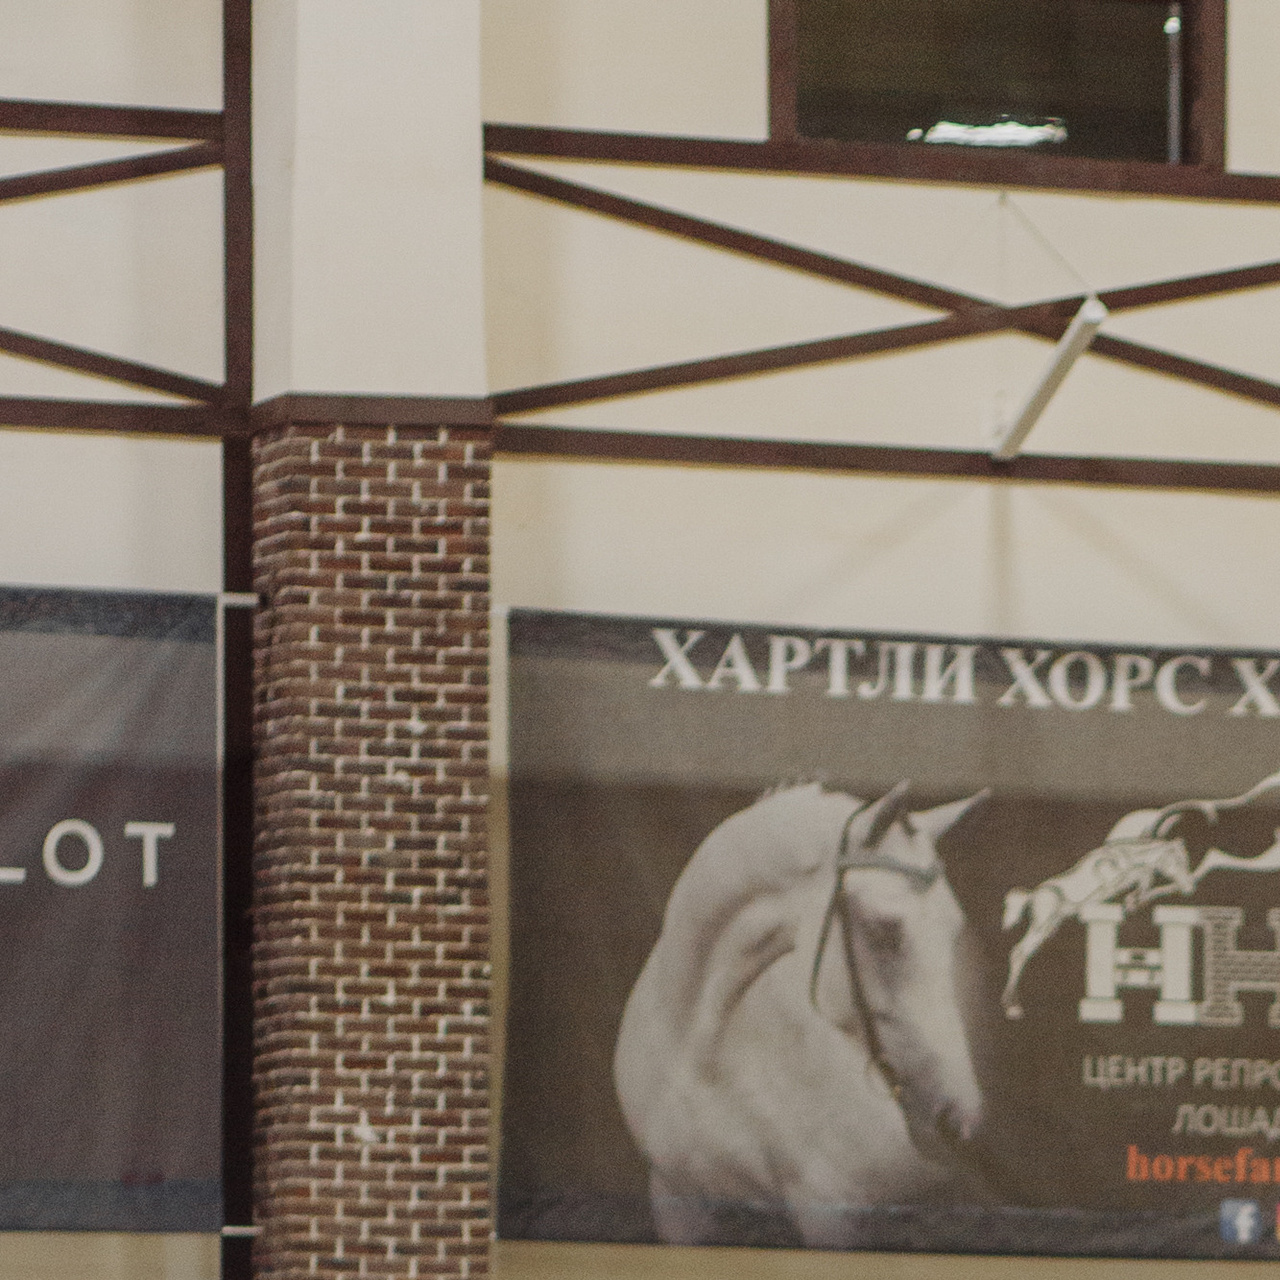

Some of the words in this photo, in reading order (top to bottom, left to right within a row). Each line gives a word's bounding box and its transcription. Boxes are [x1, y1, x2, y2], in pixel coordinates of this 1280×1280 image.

[649, 627, 977, 706] ХАРТЛИ
[998, 645, 1211, 717] ХОРС
[1082, 1055, 1187, 1089] ЦЕНТР
